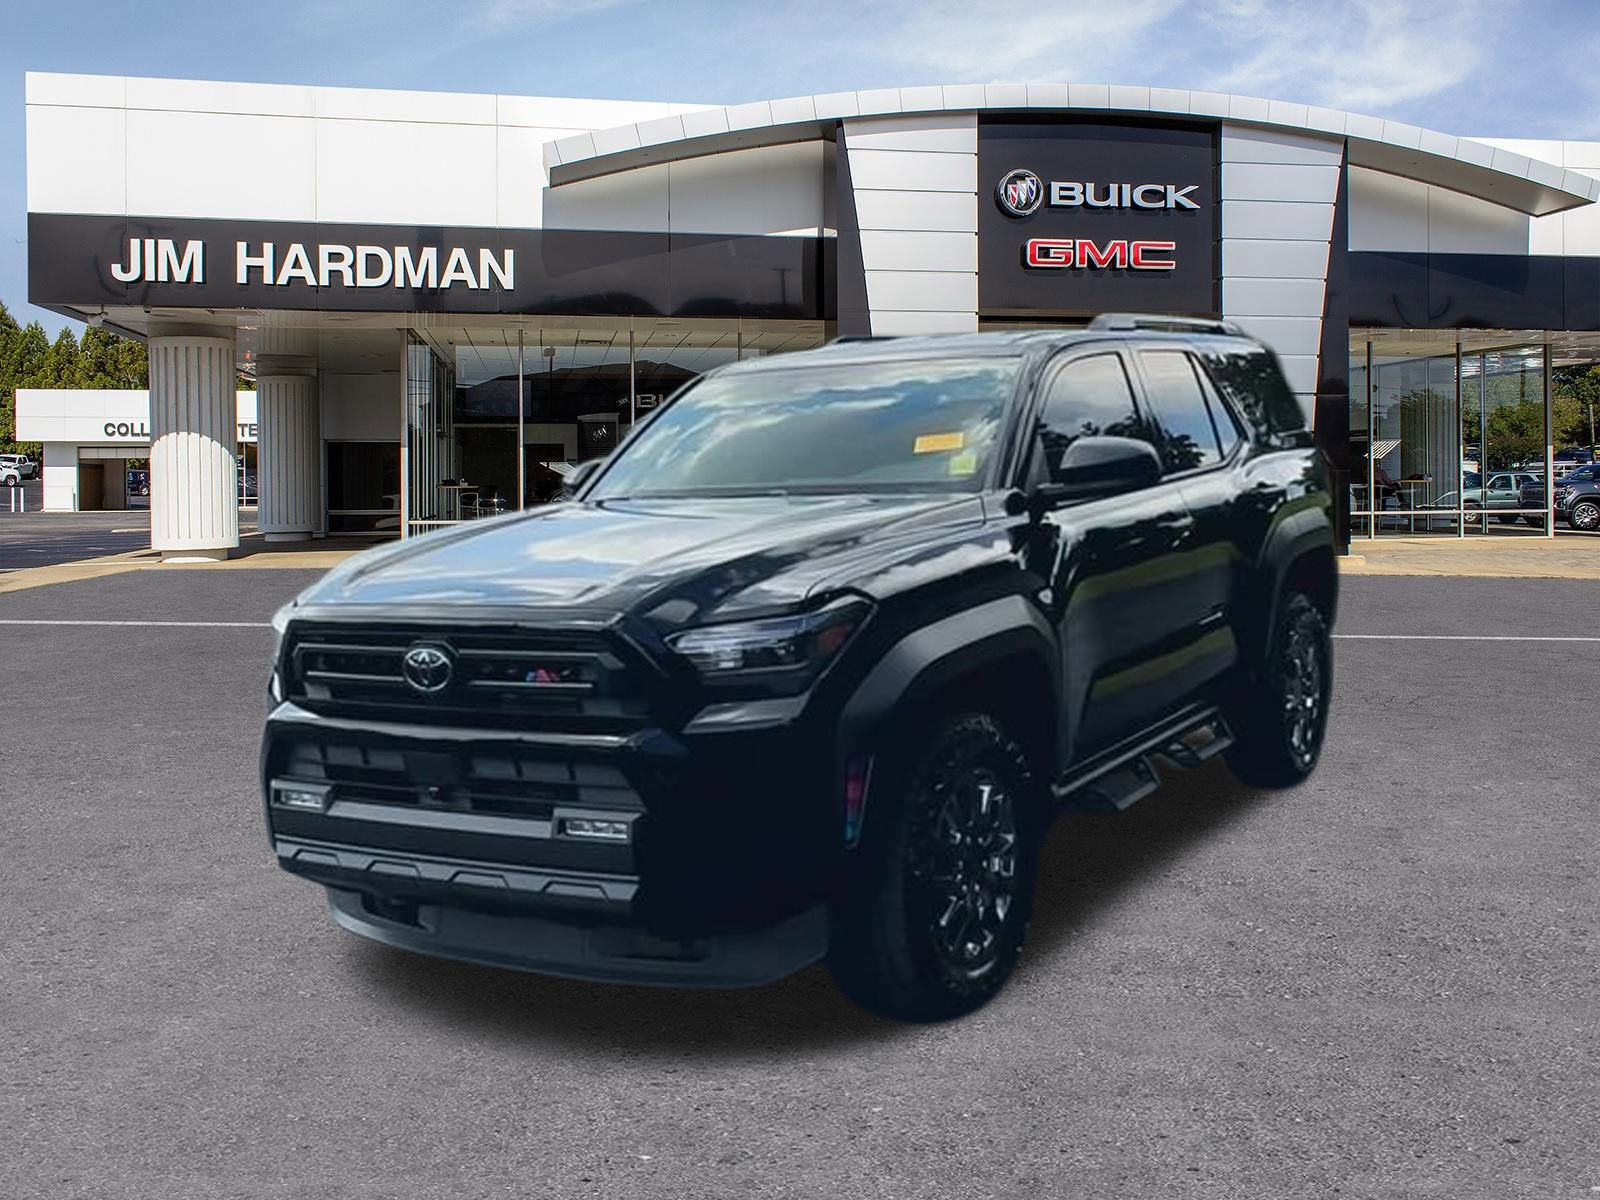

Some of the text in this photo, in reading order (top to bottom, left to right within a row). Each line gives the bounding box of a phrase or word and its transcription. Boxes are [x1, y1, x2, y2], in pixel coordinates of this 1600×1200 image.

[1050, 181, 1200, 209] BUICK
[110, 238, 515, 290] JIM HARDMAN
[1026, 238, 1176, 270] GMC
